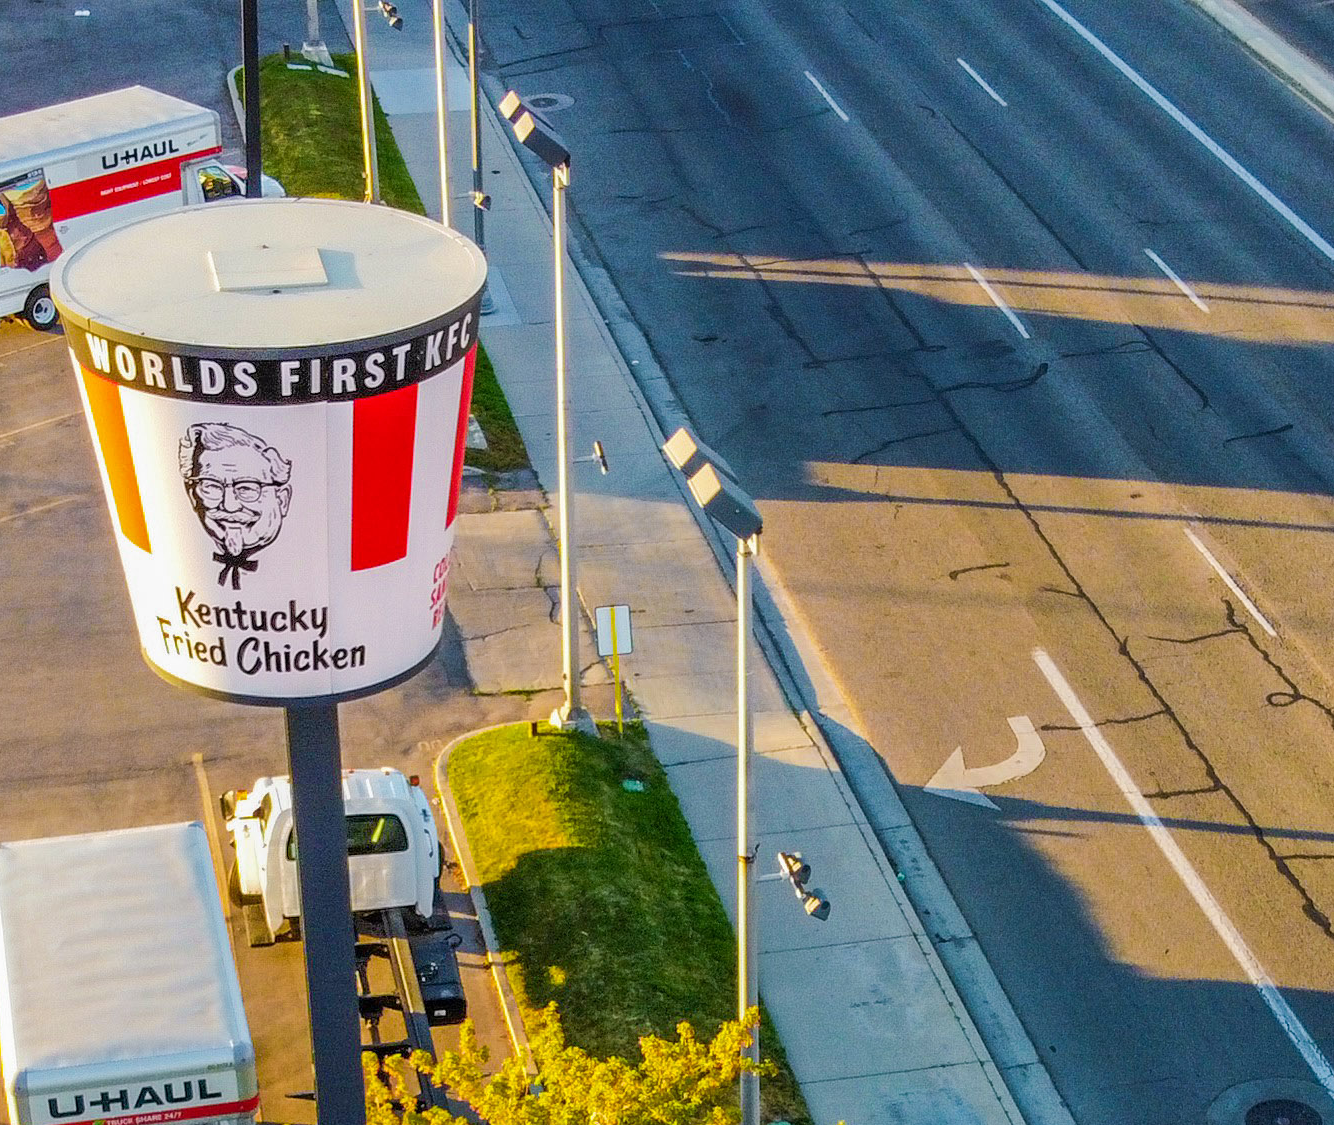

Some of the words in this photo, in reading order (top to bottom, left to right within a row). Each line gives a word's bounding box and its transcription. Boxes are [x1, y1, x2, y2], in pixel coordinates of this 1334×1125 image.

[101, 139, 180, 170] U-HAUL
[85, 331, 258, 398] WORLDS
[281, 343, 412, 397] FIRST
[424, 312, 473, 372] KFC
[175, 586, 329, 639] Kentucky
[156, 616, 228, 667] Fried
[236, 636, 367, 676] Chicken
[48, 1078, 223, 1119] U-HAUL
